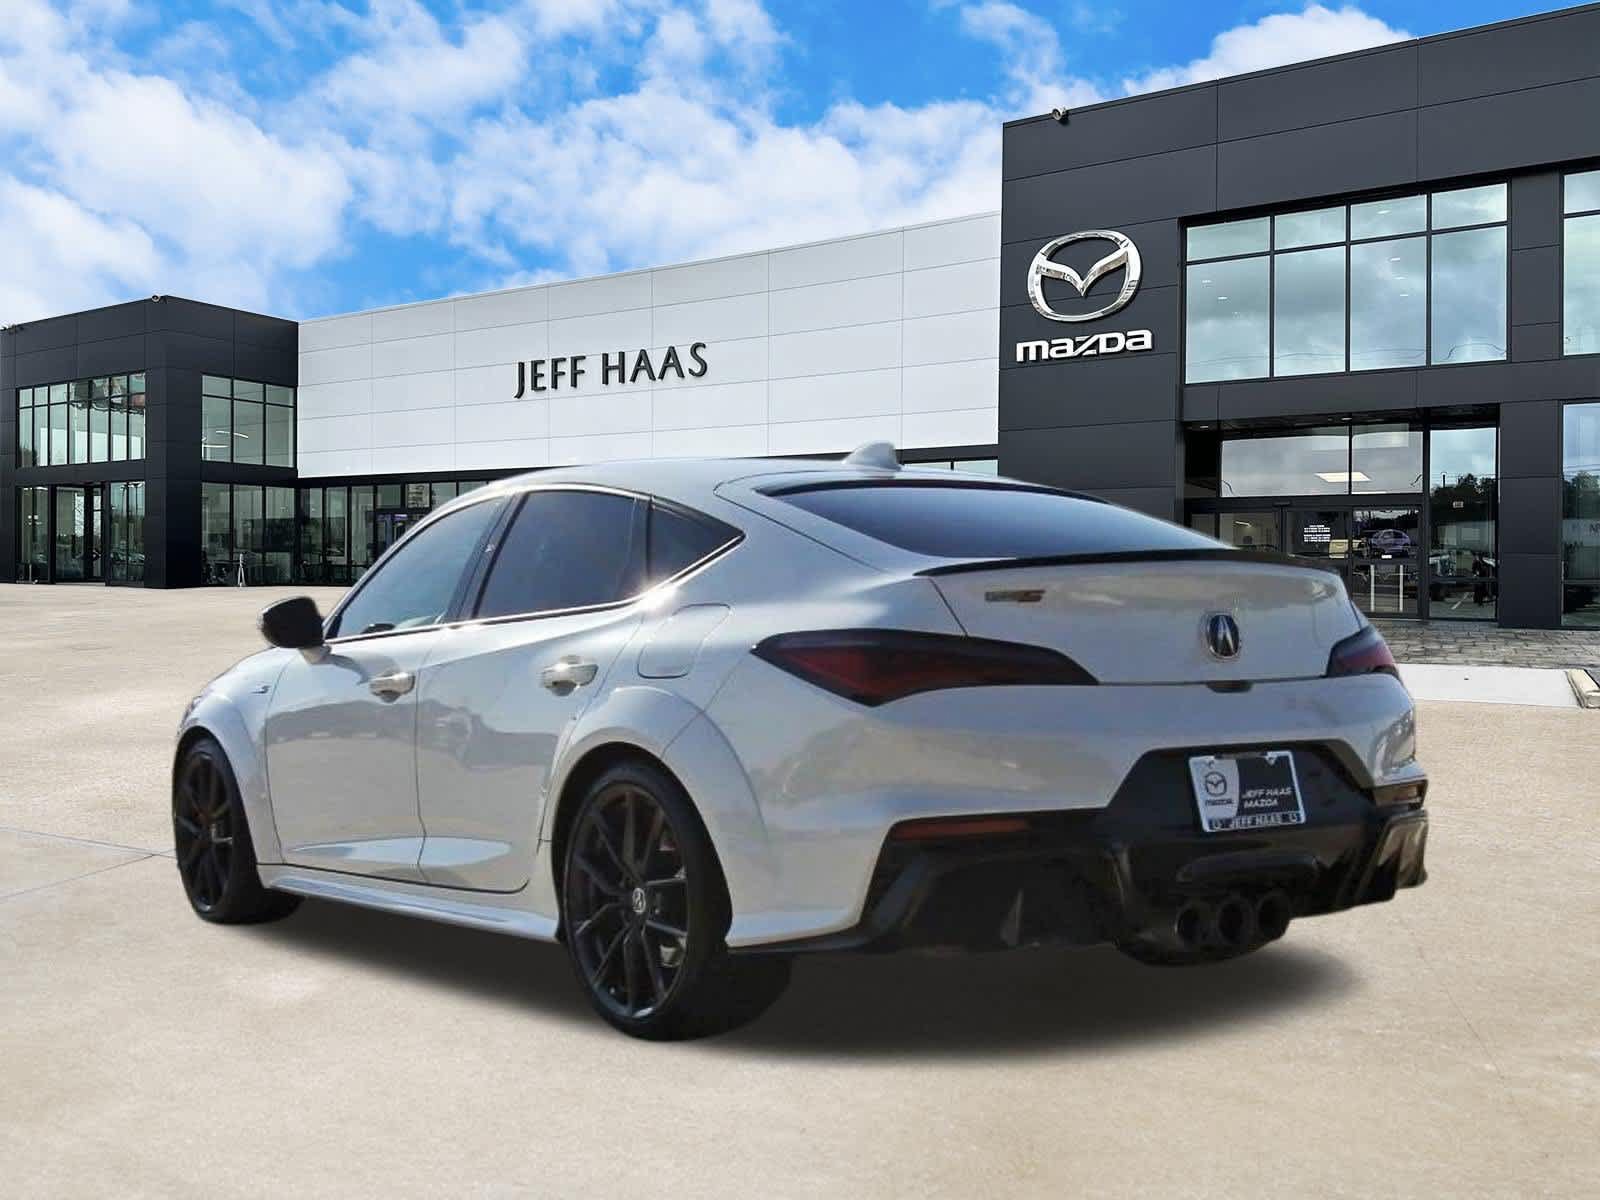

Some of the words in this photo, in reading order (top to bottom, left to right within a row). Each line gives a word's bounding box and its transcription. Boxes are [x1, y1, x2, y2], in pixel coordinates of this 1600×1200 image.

[514, 355, 586, 399] JEFF
[602, 342, 708, 385] HAAS
[1242, 789, 1265, 799] JEFF
[1266, 787, 1292, 796] HAAS
[1243, 799, 1279, 808] MAZDA
[1230, 815, 1254, 828] JEFF
[1256, 813, 1281, 826] HAAS
